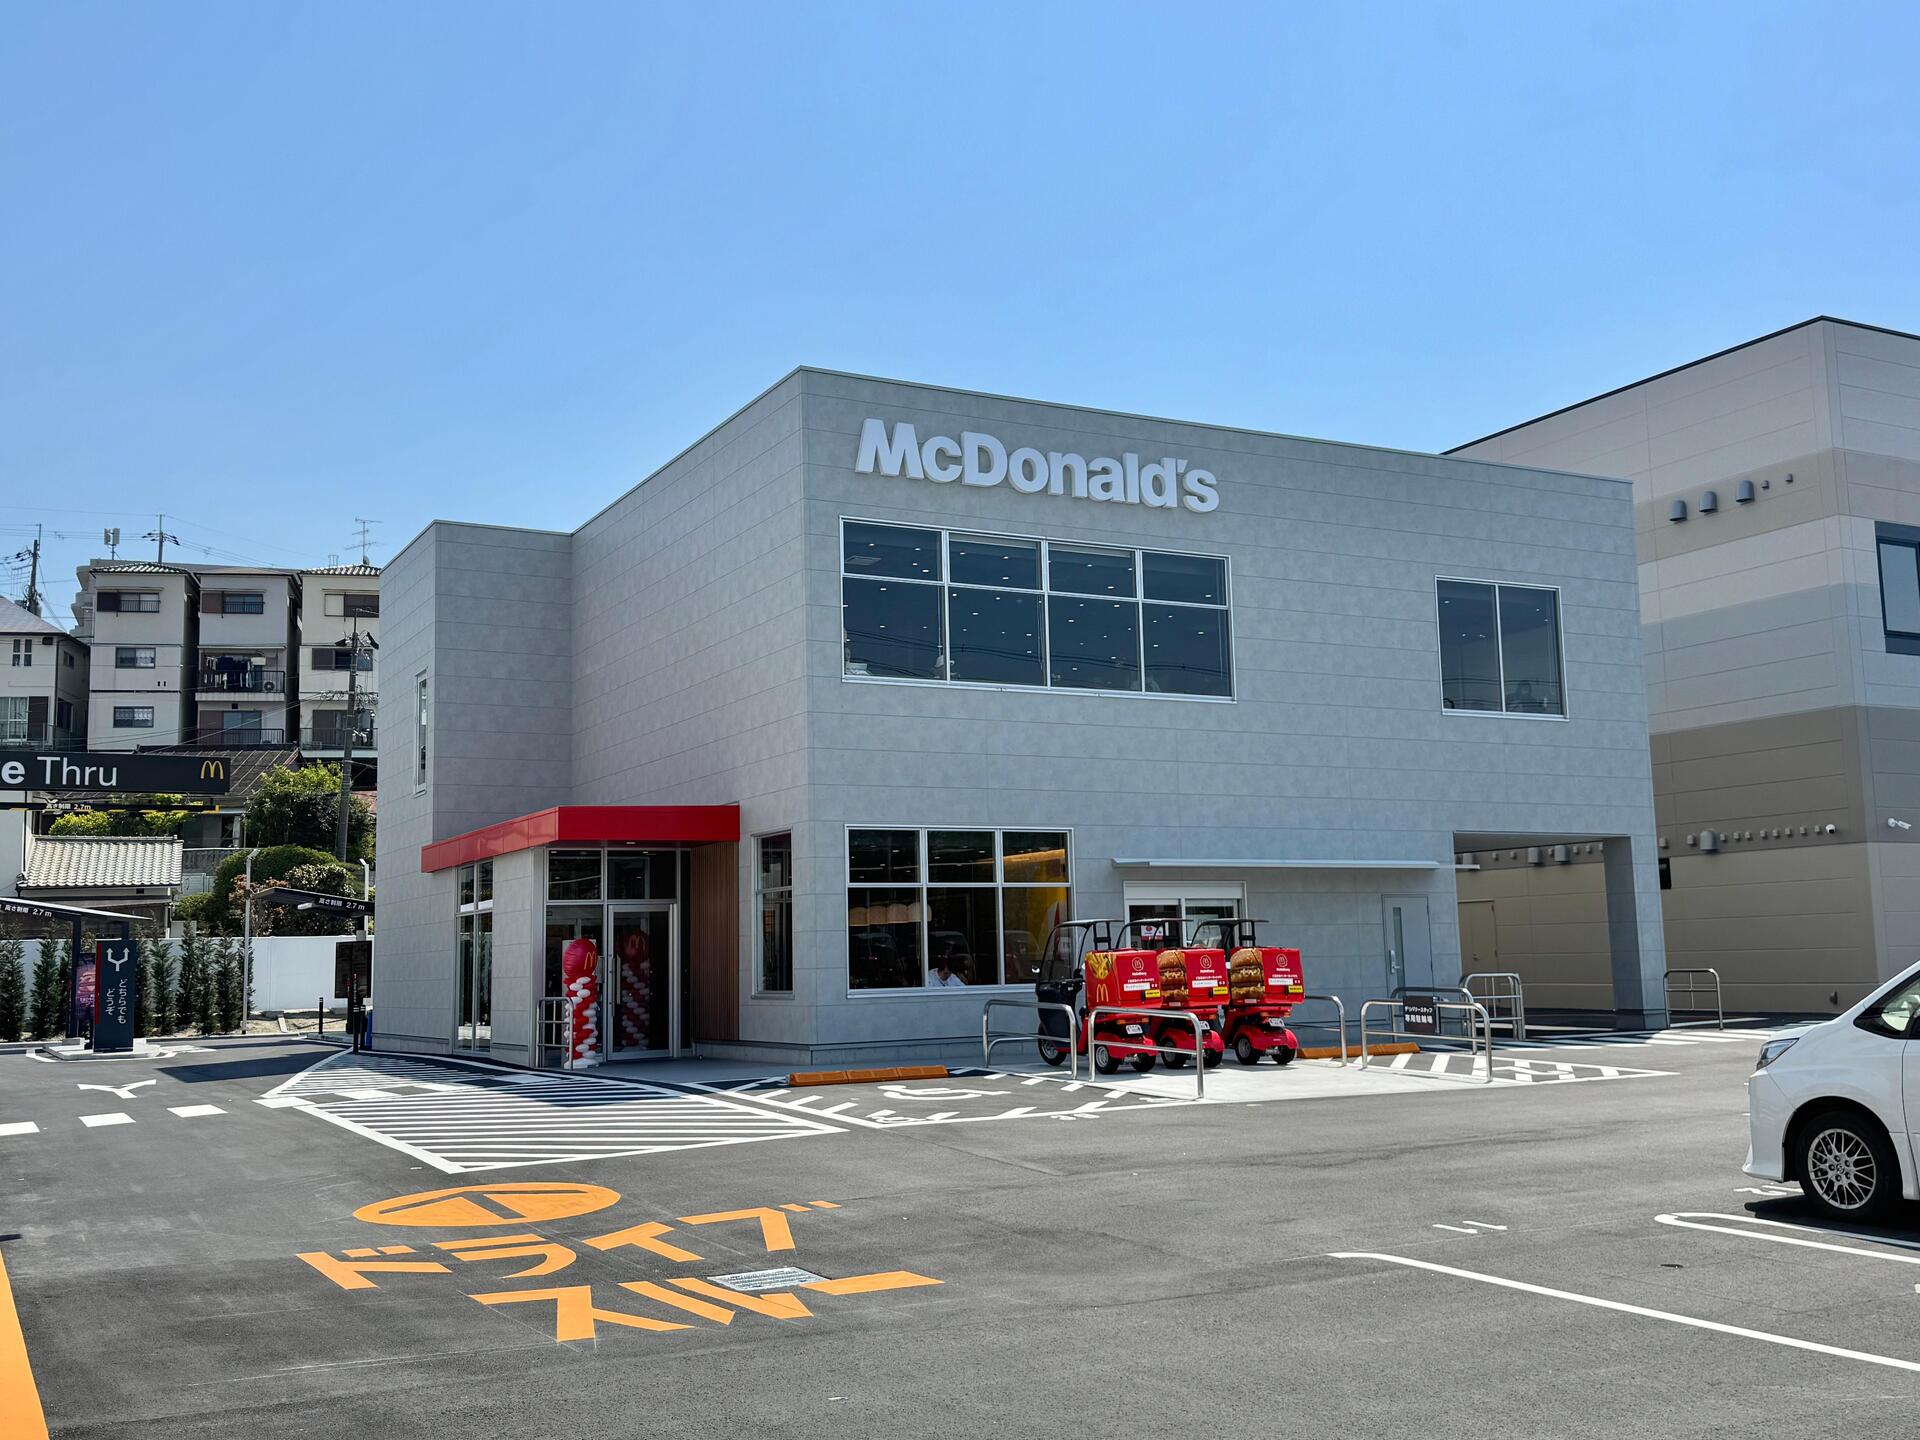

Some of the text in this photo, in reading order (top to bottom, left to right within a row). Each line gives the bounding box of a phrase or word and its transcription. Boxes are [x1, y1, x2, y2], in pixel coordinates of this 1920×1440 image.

[855, 418, 1220, 513] McDonald's
[37, 756, 118, 787] Thru
[105, 988, 116, 1015] どうぞ
[117, 978, 128, 1024] どちらでも
[296, 1200, 842, 1290] ドライブ
[468, 1270, 946, 1343] スルー
